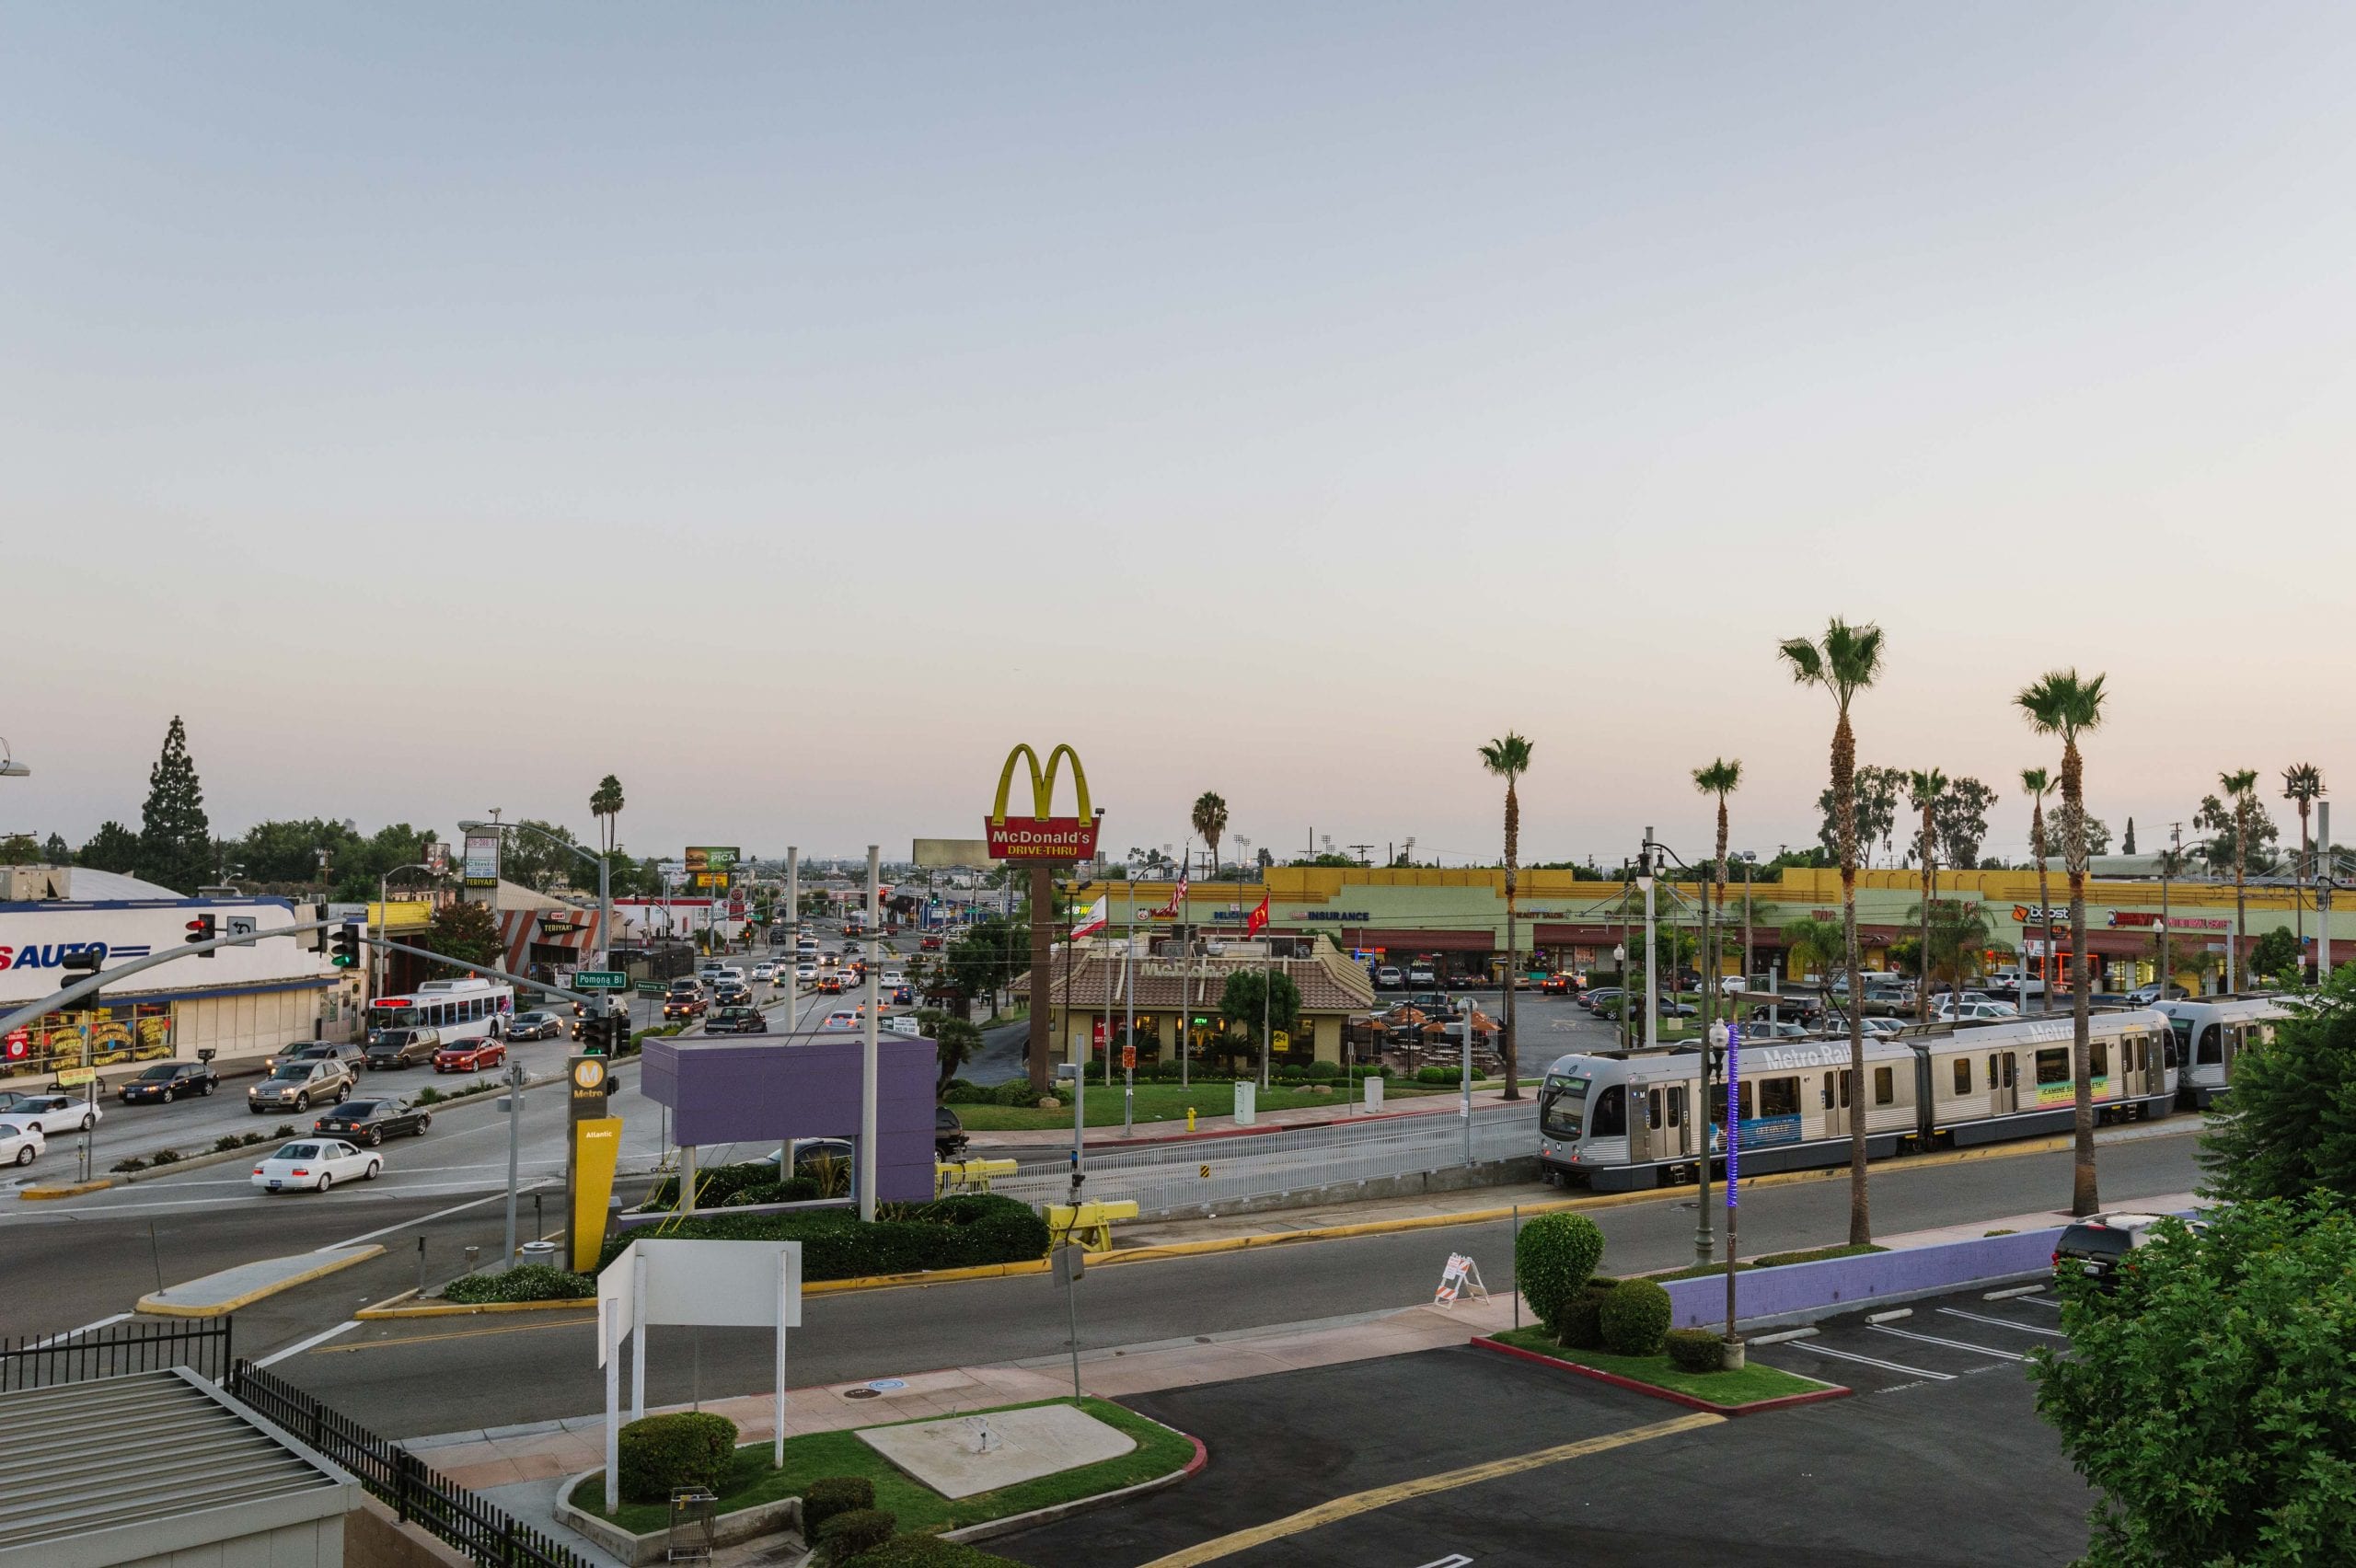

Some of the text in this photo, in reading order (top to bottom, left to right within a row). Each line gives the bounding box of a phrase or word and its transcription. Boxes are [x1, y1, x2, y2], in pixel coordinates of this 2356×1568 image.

[993, 831, 1090, 844] McDonald's
[1008, 846, 1077, 855] DRIVE-THRU
[1062, 905, 1093, 915] SUBW
[1308, 911, 1369, 921] INSURANCE
[544, 924, 572, 932] TERIYAKI
[1140, 962, 1266, 977] McDonald's
[580, 975, 622, 984] Pomona Bl
[2028, 1023, 2075, 1043] Metro
[1763, 1040, 1852, 1070] Metro Rail
[574, 1090, 603, 1099] Metro
